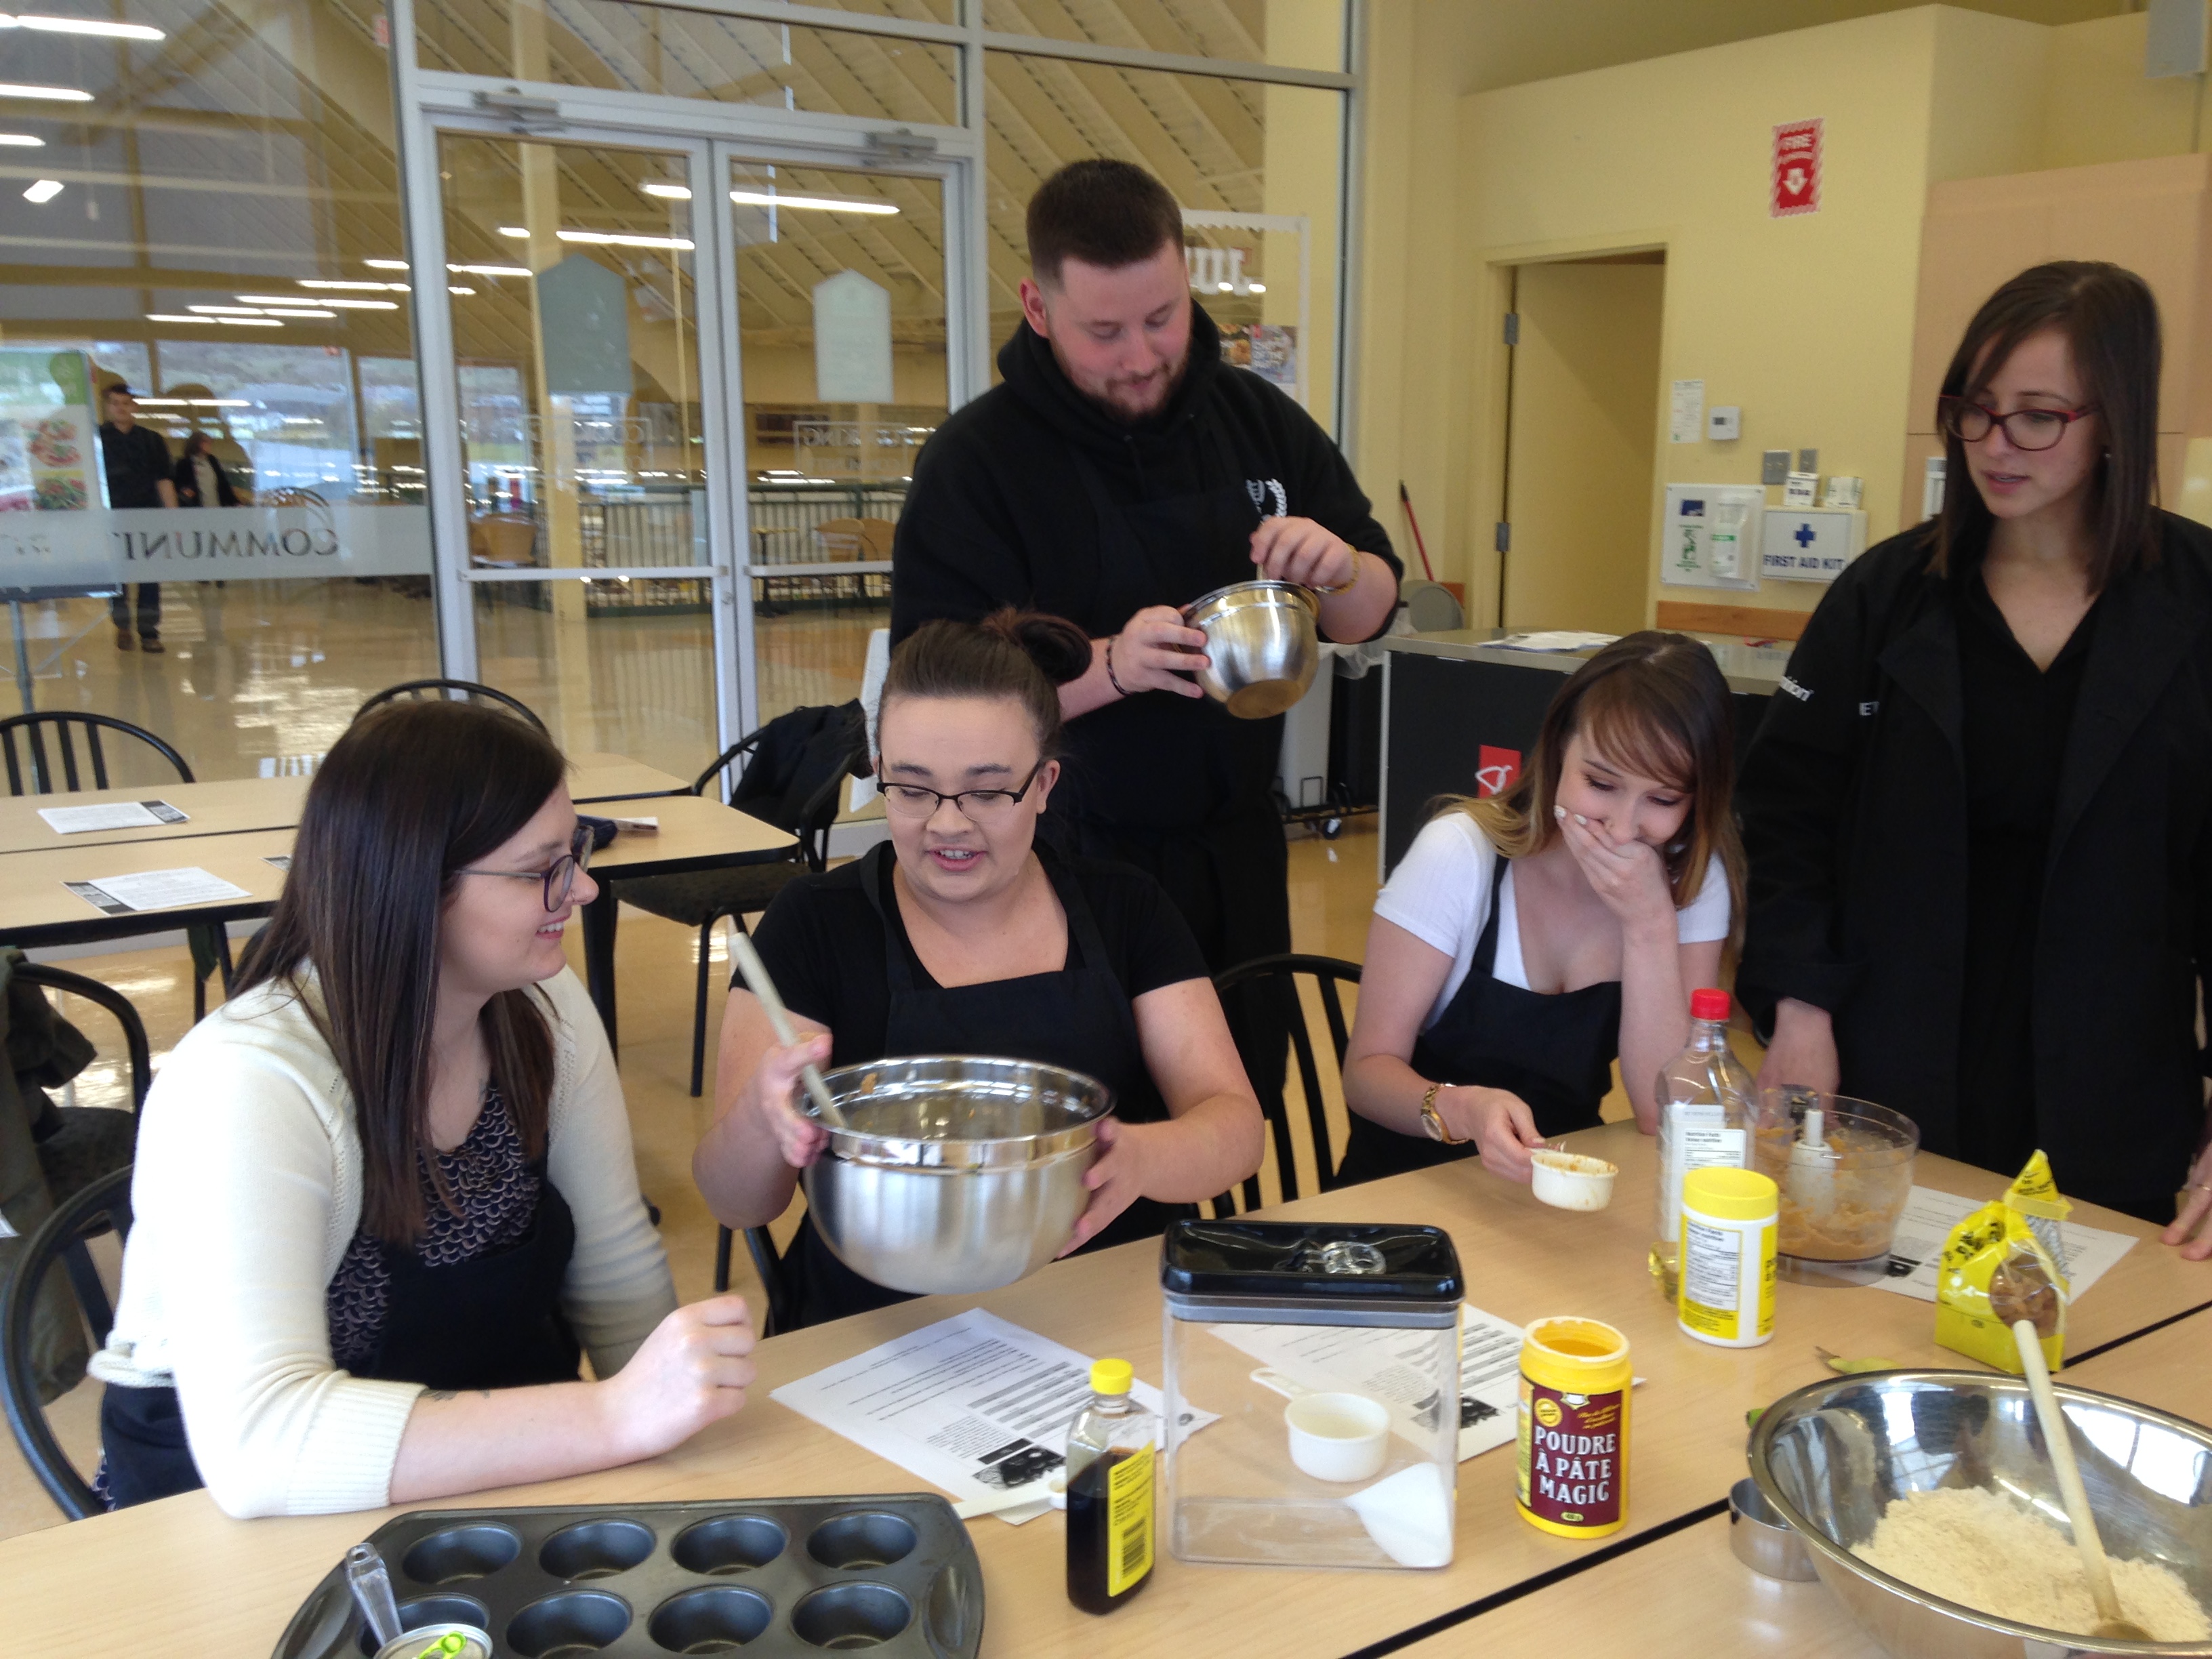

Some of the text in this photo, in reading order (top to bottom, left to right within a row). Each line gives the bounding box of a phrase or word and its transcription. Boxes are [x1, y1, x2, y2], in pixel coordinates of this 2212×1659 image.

[1763, 554, 1845, 570] FIRST AID KIT
[1534, 1425, 1616, 1455] POUDRE
[1555, 1456, 1612, 1480] PÂTE
[1539, 1475, 1610, 1505] MAGIC
